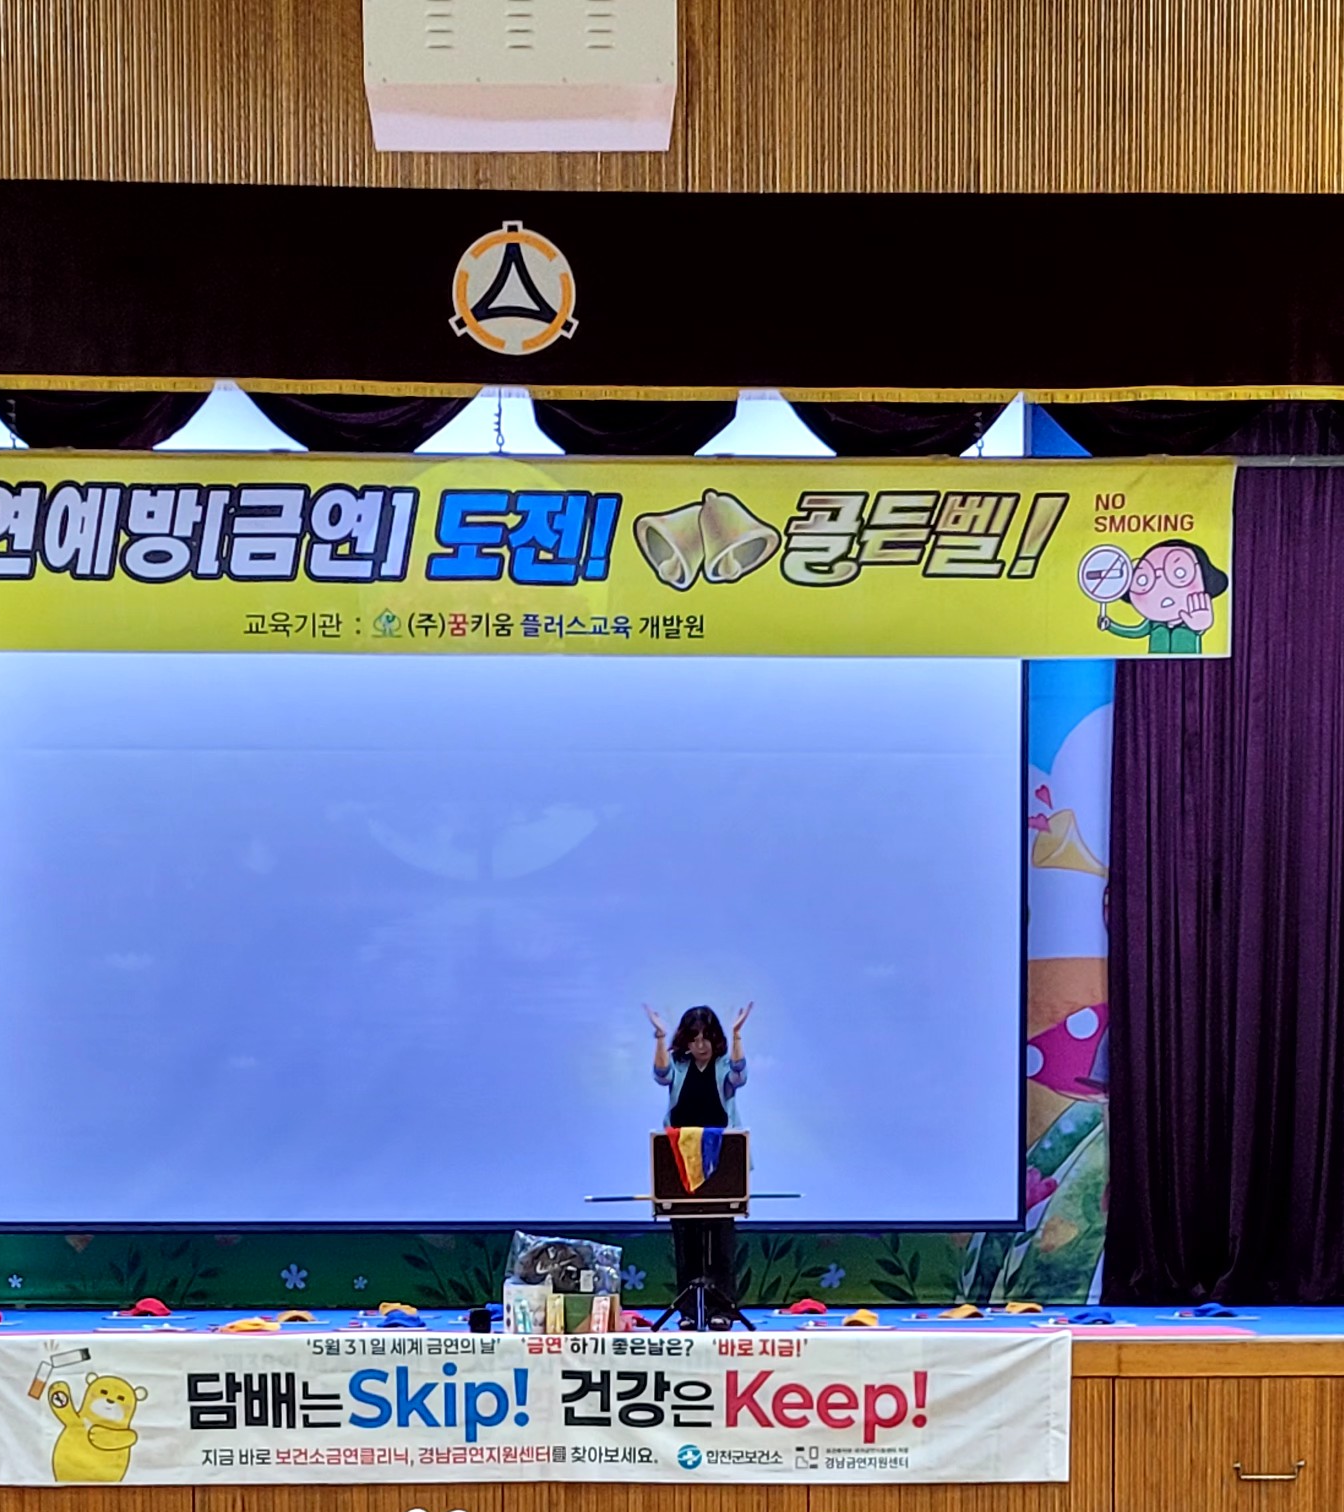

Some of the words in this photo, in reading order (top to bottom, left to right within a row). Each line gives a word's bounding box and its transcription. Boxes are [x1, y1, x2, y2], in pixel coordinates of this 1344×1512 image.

[1095, 493, 1126, 512] NO
[1094, 512, 1195, 534] SMOKING
[425, 488, 623, 585] 도전!
[781, 489, 1070, 586] 골든벨!
[243, 612, 343, 638] 교육기관
[407, 612, 514, 638] (주)꿈키움
[519, 613, 633, 639] 플러스교육
[638, 614, 705, 639] 개발원
[344, 1338, 387, 1355] 31일
[390, 1338, 423, 1356] 세계
[426, 1338, 476, 1355] 금연의
[560, 1369, 714, 1429] 건강은
[725, 1369, 930, 1444] Keep!
[201, 1448, 234, 1466] 지금
[238, 1448, 272, 1466] 바로
[570, 1446, 659, 1465] 찾아보세요.
